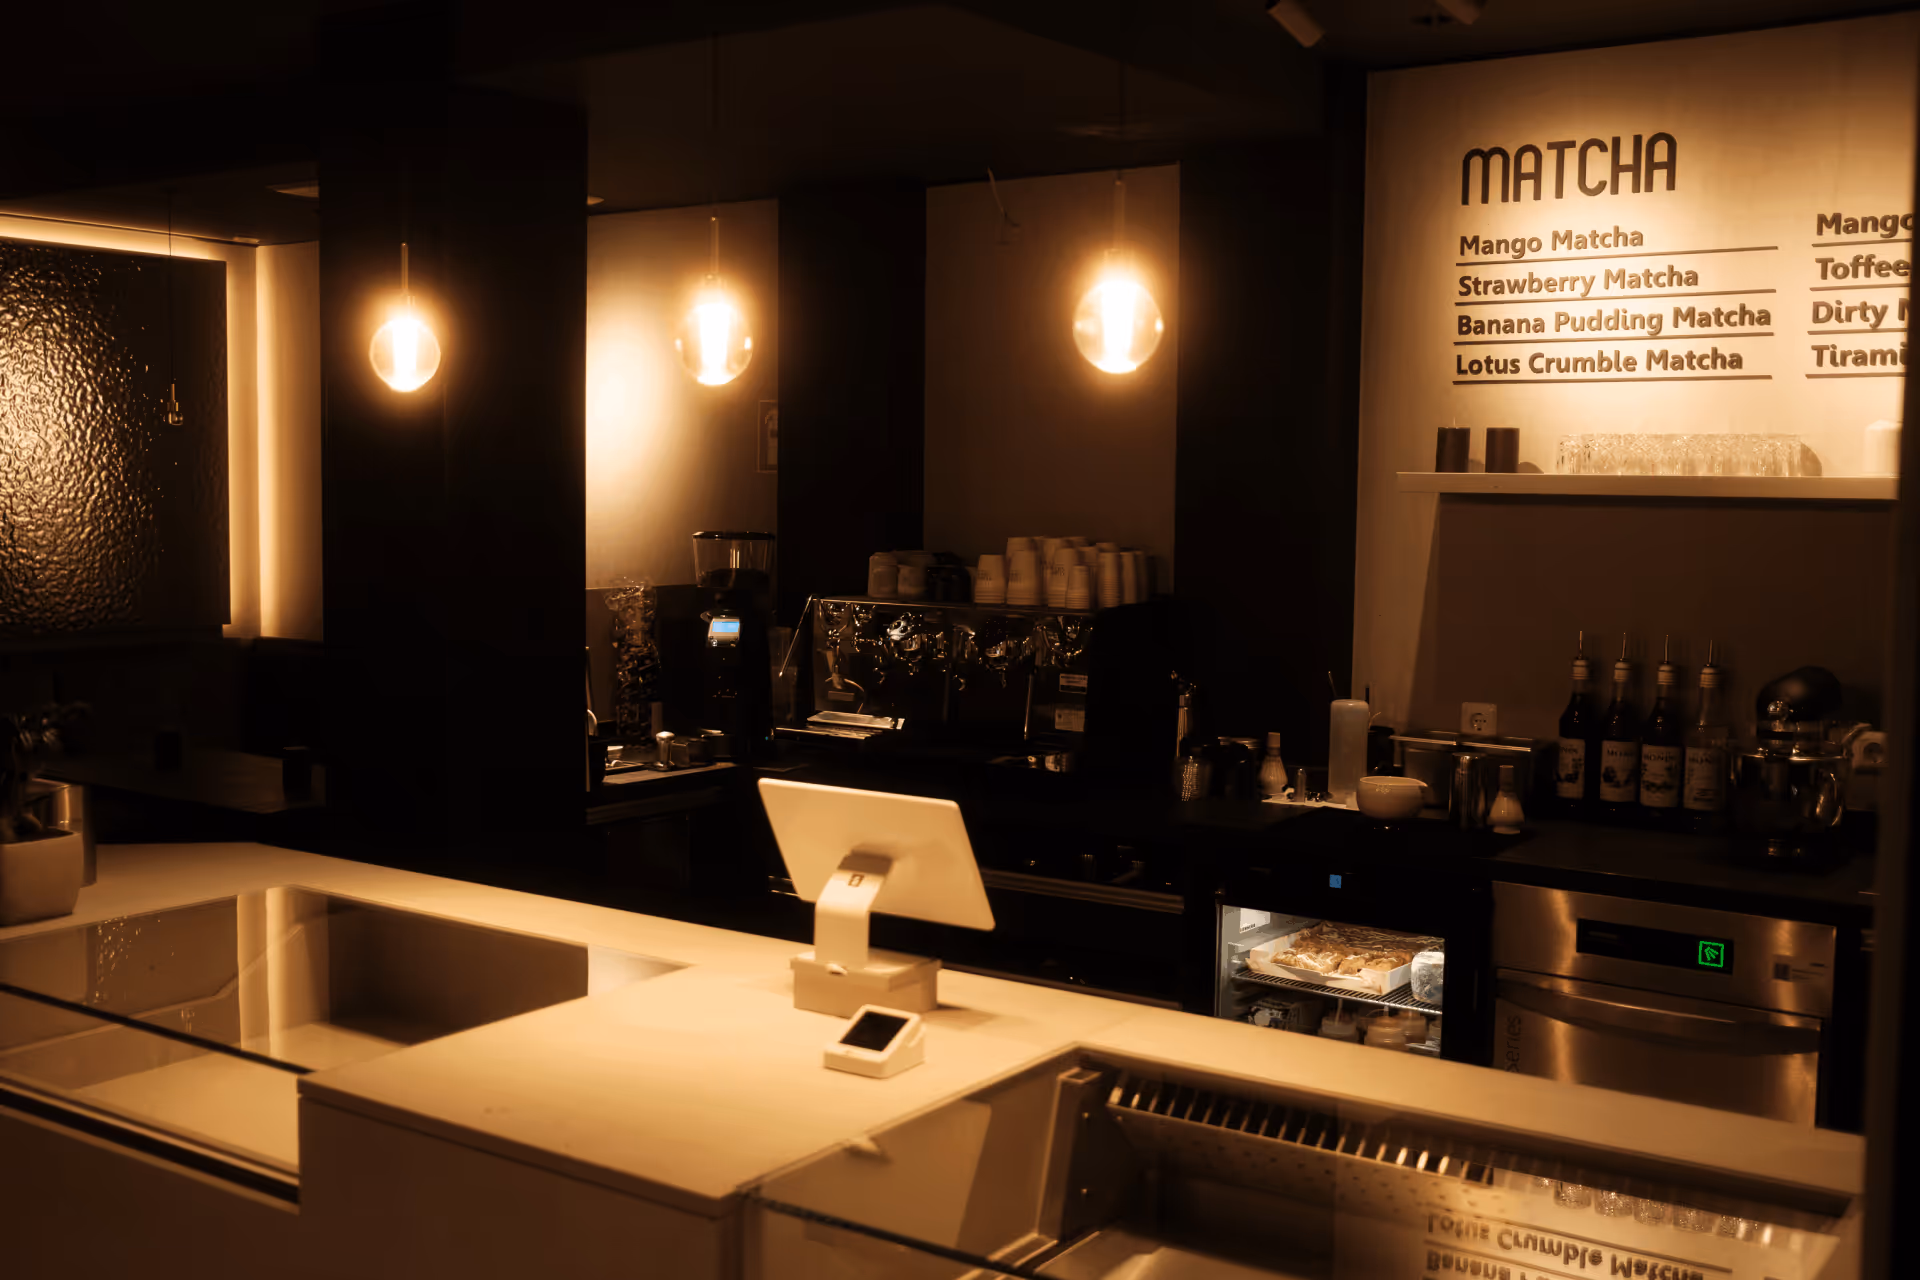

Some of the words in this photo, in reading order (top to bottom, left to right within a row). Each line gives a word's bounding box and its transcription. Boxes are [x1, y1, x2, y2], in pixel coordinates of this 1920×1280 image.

[1461, 132, 1677, 205] MATCHA
[1460, 235, 1542, 259] Mango
[1552, 225, 1643, 251] Matcha
[1458, 272, 1596, 298] Strawberry
[1604, 264, 1698, 290] Matcha
[1815, 254, 1911, 280] Toffee
[1457, 315, 1546, 335] Banana
[1555, 308, 1663, 336] Pudding
[1673, 303, 1771, 328] Matcha
[1812, 300, 1889, 329] Dirty
[1456, 354, 1520, 375] Lotus
[1528, 349, 1637, 374] Crumble
[1646, 347, 1743, 371] Matcha
